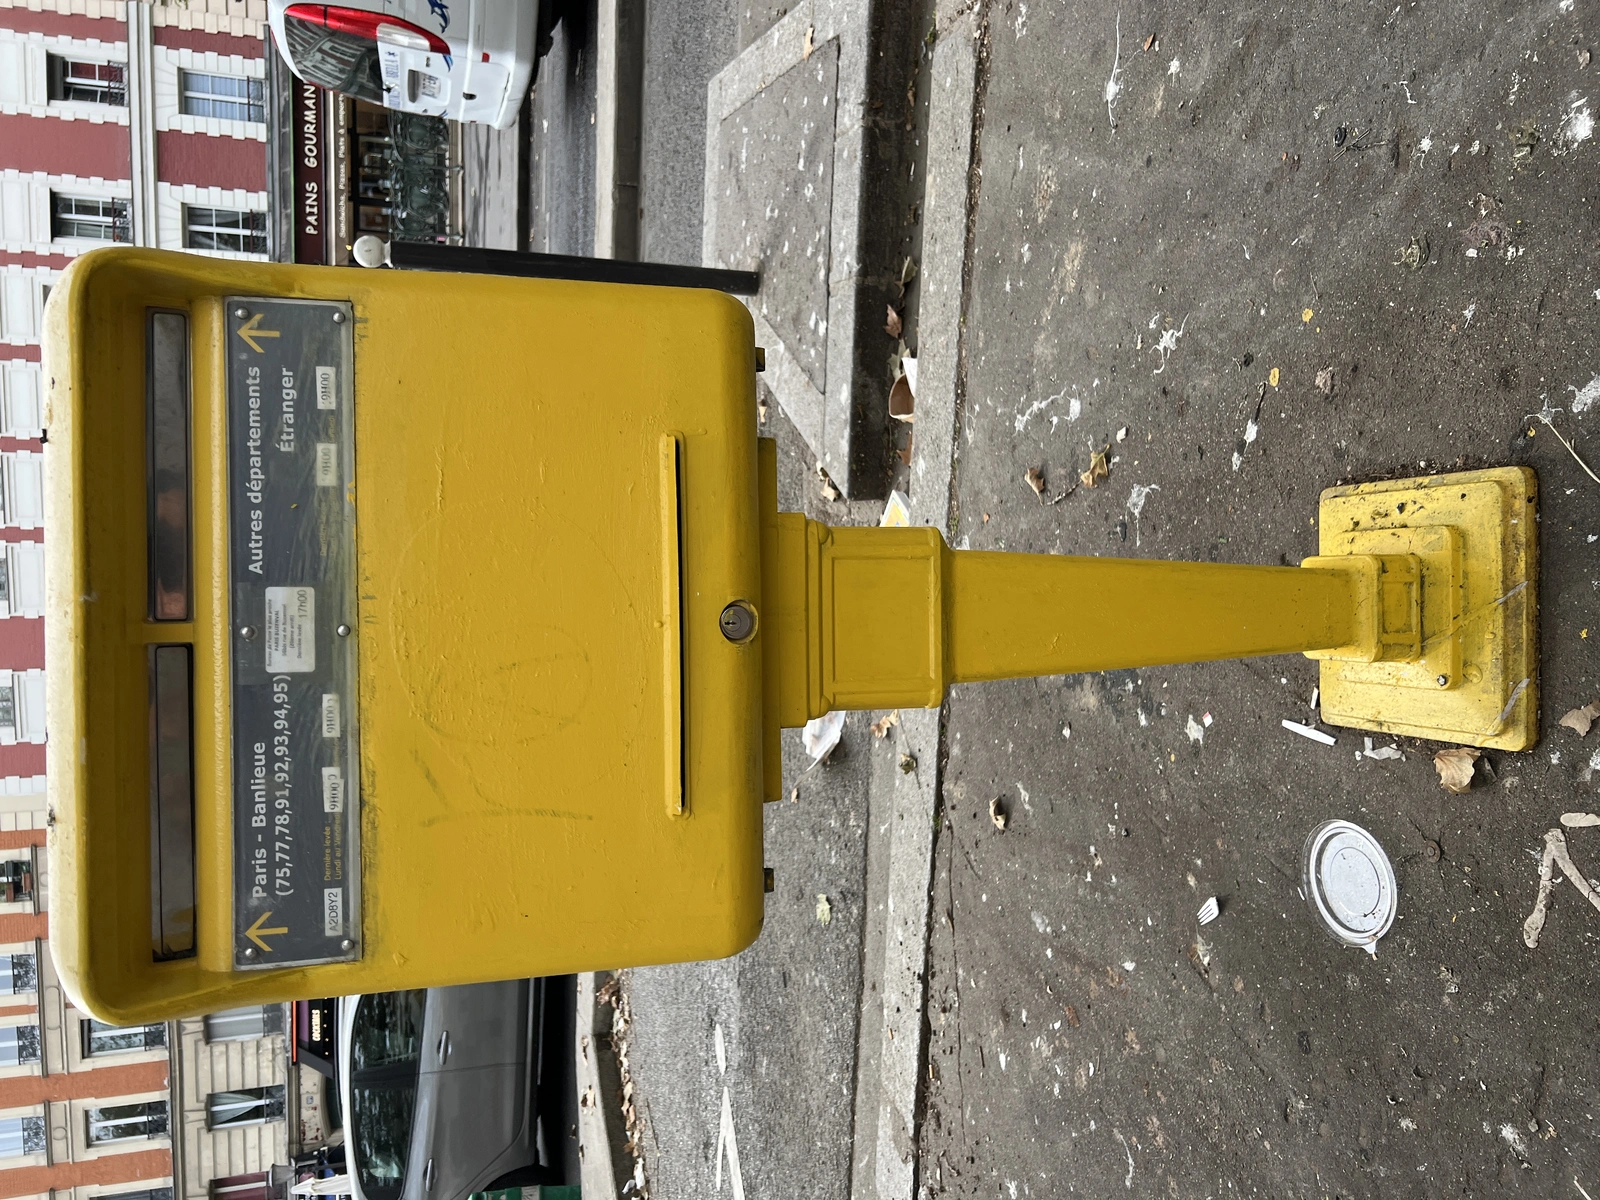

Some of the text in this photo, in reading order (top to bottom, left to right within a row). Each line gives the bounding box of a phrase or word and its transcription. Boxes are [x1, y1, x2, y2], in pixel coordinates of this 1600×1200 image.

[303, 81, 318, 235] PAINS GOURMAN
[275, 367, 297, 452] Étranger
[246, 366, 265, 574] Autres départements
[297, 590, 308, 618] 17h00
[251, 742, 266, 827] Banlieue
[273, 675, 294, 896] (75,77,78,91,92,93,94,95)
[329, 782, 340, 810] 9H00
[323, 826, 331, 846] levée
[335, 848, 341, 857] au
[252, 848, 267, 898] Paris
[323, 848, 331, 880] Dernière
[334, 860, 342, 880] Lundi
[328, 892, 338, 932] A2D8Y2
[312, 1009, 321, 1041] COCKTAILS
